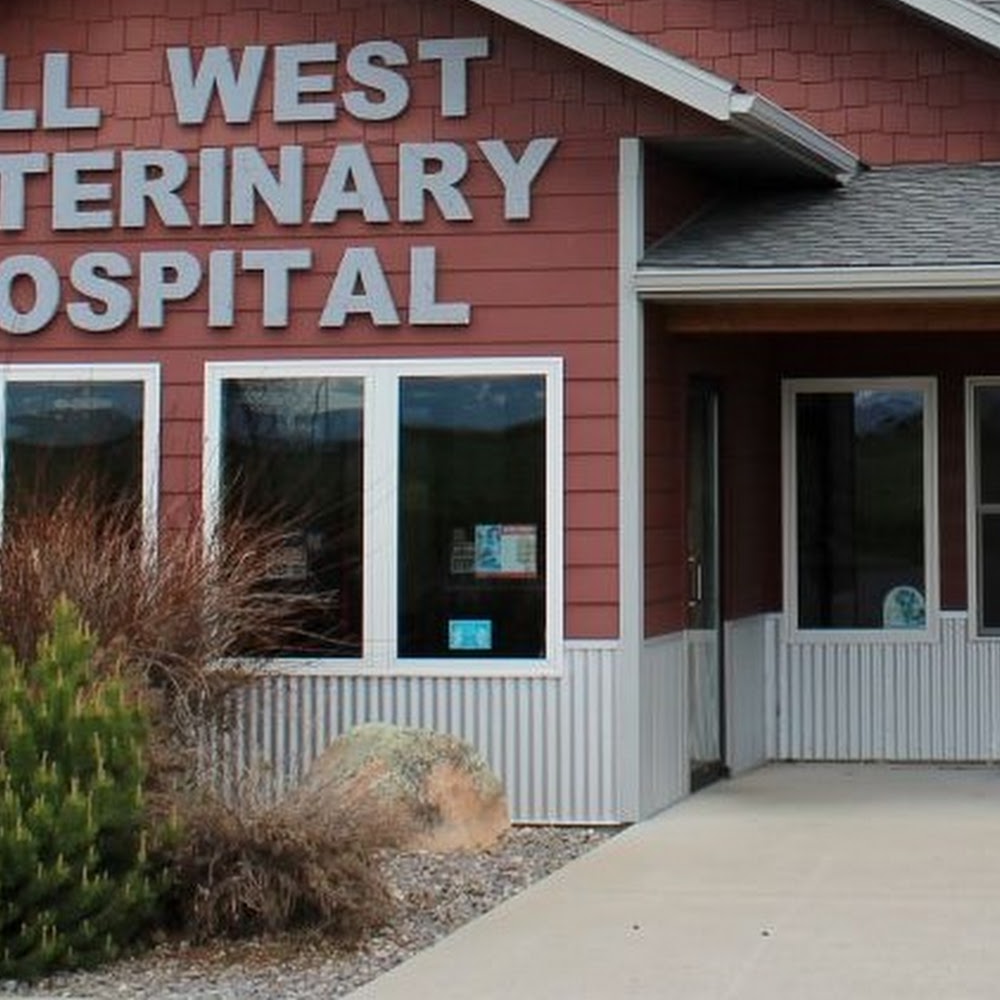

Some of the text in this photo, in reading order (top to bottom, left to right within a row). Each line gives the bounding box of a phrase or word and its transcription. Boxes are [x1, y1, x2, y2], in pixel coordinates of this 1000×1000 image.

[166, 37, 489, 124] WEST
[0, 138, 558, 231] TERINARY
[0, 246, 472, 334] OSPITAL
